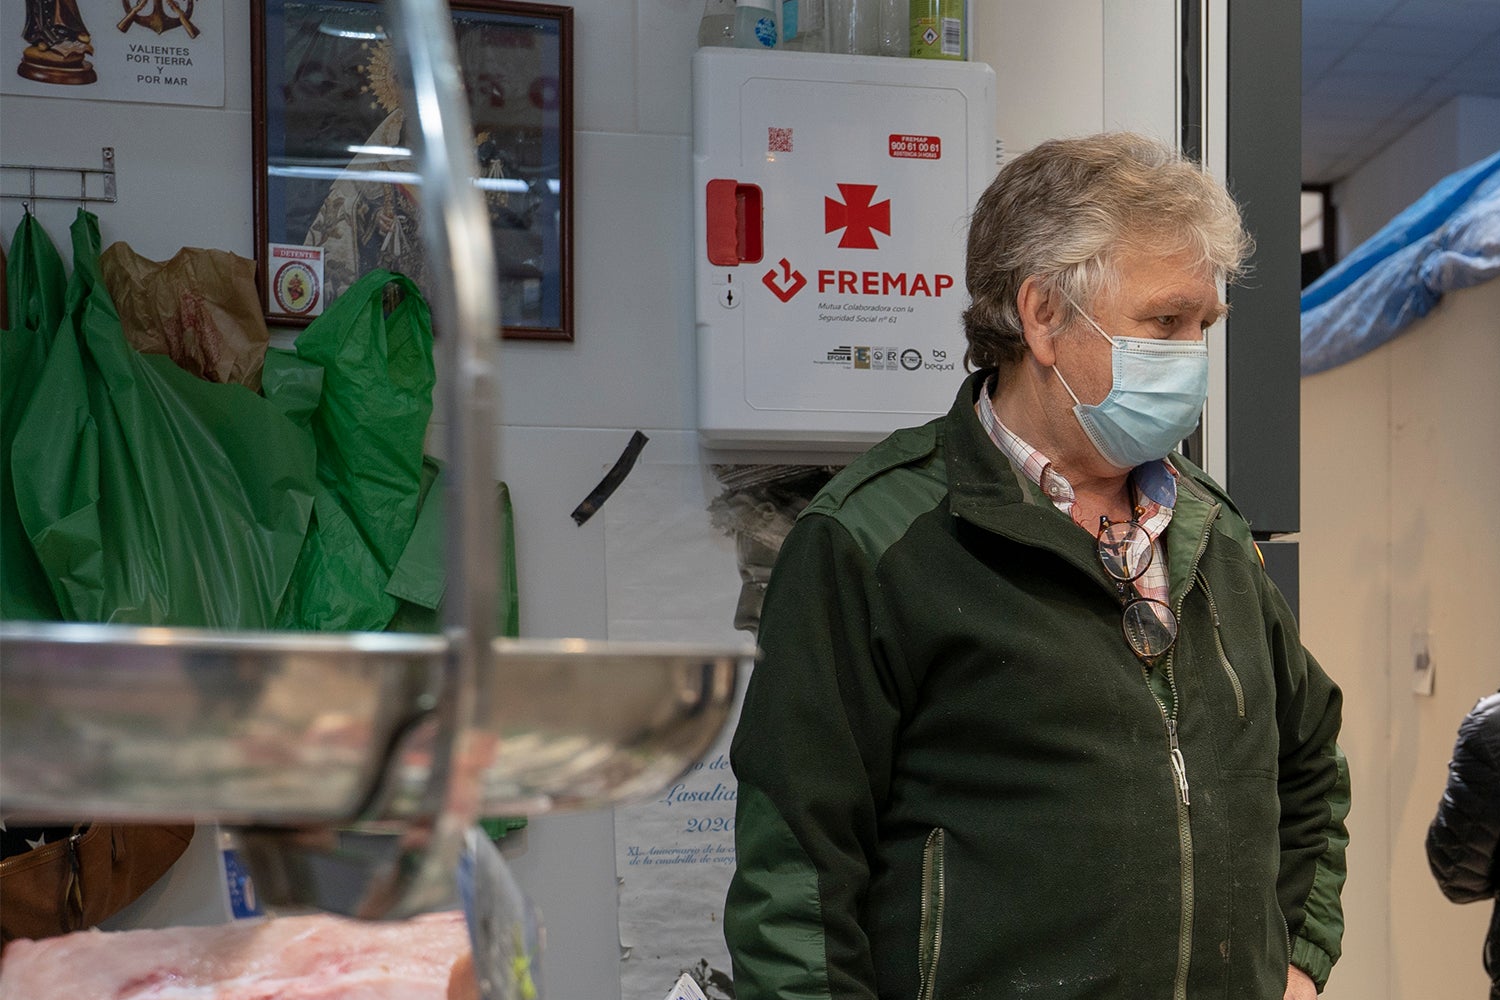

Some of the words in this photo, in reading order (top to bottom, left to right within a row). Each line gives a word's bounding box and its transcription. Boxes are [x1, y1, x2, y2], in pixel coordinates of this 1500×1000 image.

[129, 44, 190, 56] VALIENTES
[126, 54, 150, 63] POR
[154, 56, 193, 66] TIERRA
[156, 66, 164, 74] Y
[137, 75, 160, 84] POR
[164, 77, 188, 86] MAR
[891, 141, 906, 150] 900
[907, 142, 917, 151] 61
[918, 143, 929, 151] 00
[930, 143, 939, 152] 61
[818, 270, 954, 298] FREMAP
[818, 302, 841, 310] Mutua
[842, 303, 891, 313] Colaboradora
[818, 313, 855, 323] Seguridad
[855, 314, 878, 323] Social
[888, 316, 898, 324] 61
[924, 361, 954, 371] bequal
[709, 754, 729, 770] de
[658, 781, 736, 806] Lasalia
[686, 816, 735, 833] 2020
[648, 846, 700, 856] Aniversario
[702, 844, 713, 854] de
[716, 844, 726, 854] la
[629, 856, 639, 865] de
[642, 856, 653, 865] la
[655, 854, 697, 865] cuadrilla
[699, 854, 710, 864] de
[712, 856, 736, 866] carg
